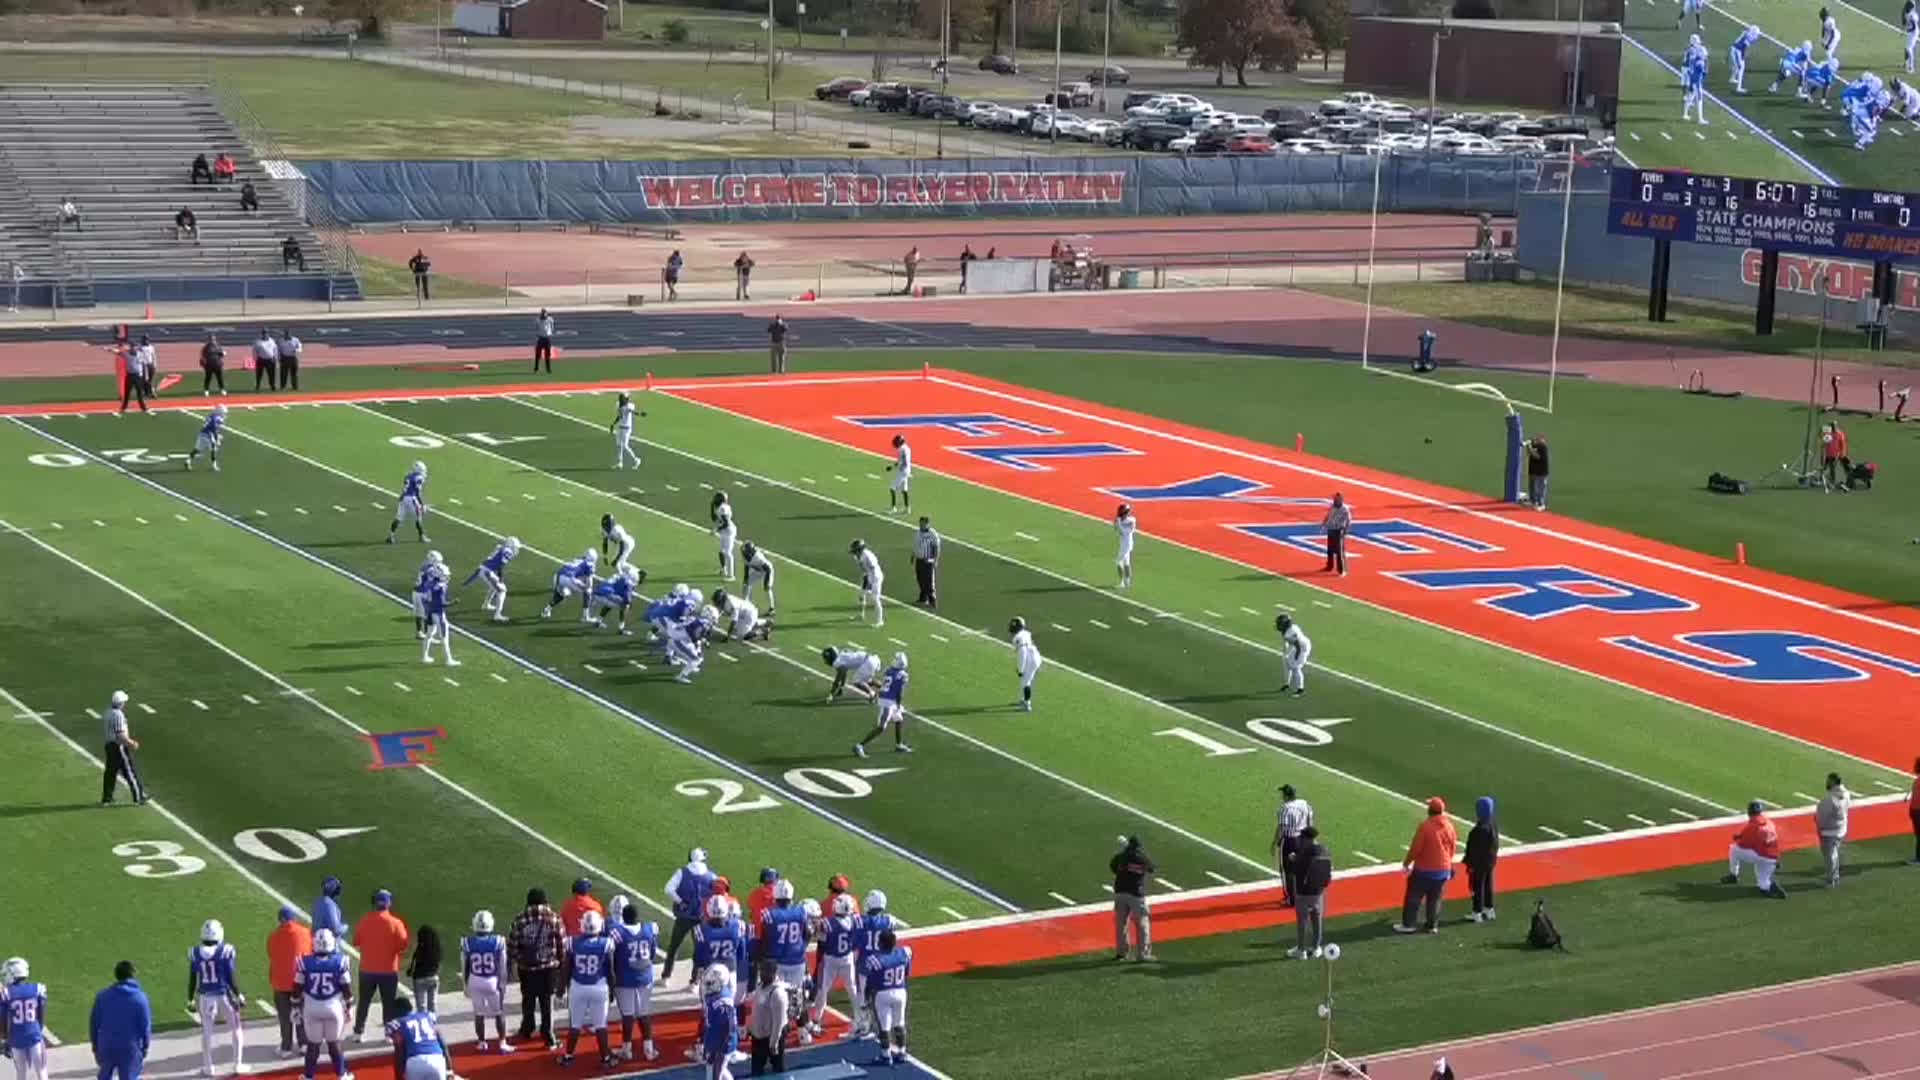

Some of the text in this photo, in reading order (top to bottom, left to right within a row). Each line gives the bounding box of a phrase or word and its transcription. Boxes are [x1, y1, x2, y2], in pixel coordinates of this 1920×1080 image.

[637, 171, 1125, 209] WELCOME TO FLYER NATION
[1642, 183, 1653, 202] 0
[1722, 177, 1731, 192] 3
[1756, 181, 1797, 202] 6:07
[1810, 185, 1818, 200] 3
[1684, 191, 1692, 206] 3
[1726, 195, 1738, 210] 16
[1803, 203, 1816, 218] 16
[1899, 207, 1910, 227] 0
[1696, 209, 1835, 236] STATE CHAMPIONS
[1741, 247, 1828, 296] CTY
[1824, 258, 1874, 303] OF
[27, 447, 174, 469] 20
[832, 413, 1920, 684] FLYERS
[1153, 716, 1335, 759] 10
[356, 725, 448, 773] F
[674, 767, 873, 815] 20
[111, 827, 328, 878] 30
[777, 922, 801, 945] 78
[838, 933, 849, 953] 6
[709, 939, 734, 959] 72
[200, 960, 219, 984] 11
[470, 952, 495, 974] 29
[575, 954, 599, 976] 58
[309, 972, 335, 995] 75
[883, 966, 905, 987] 90
[406, 1018, 437, 1044] 74
